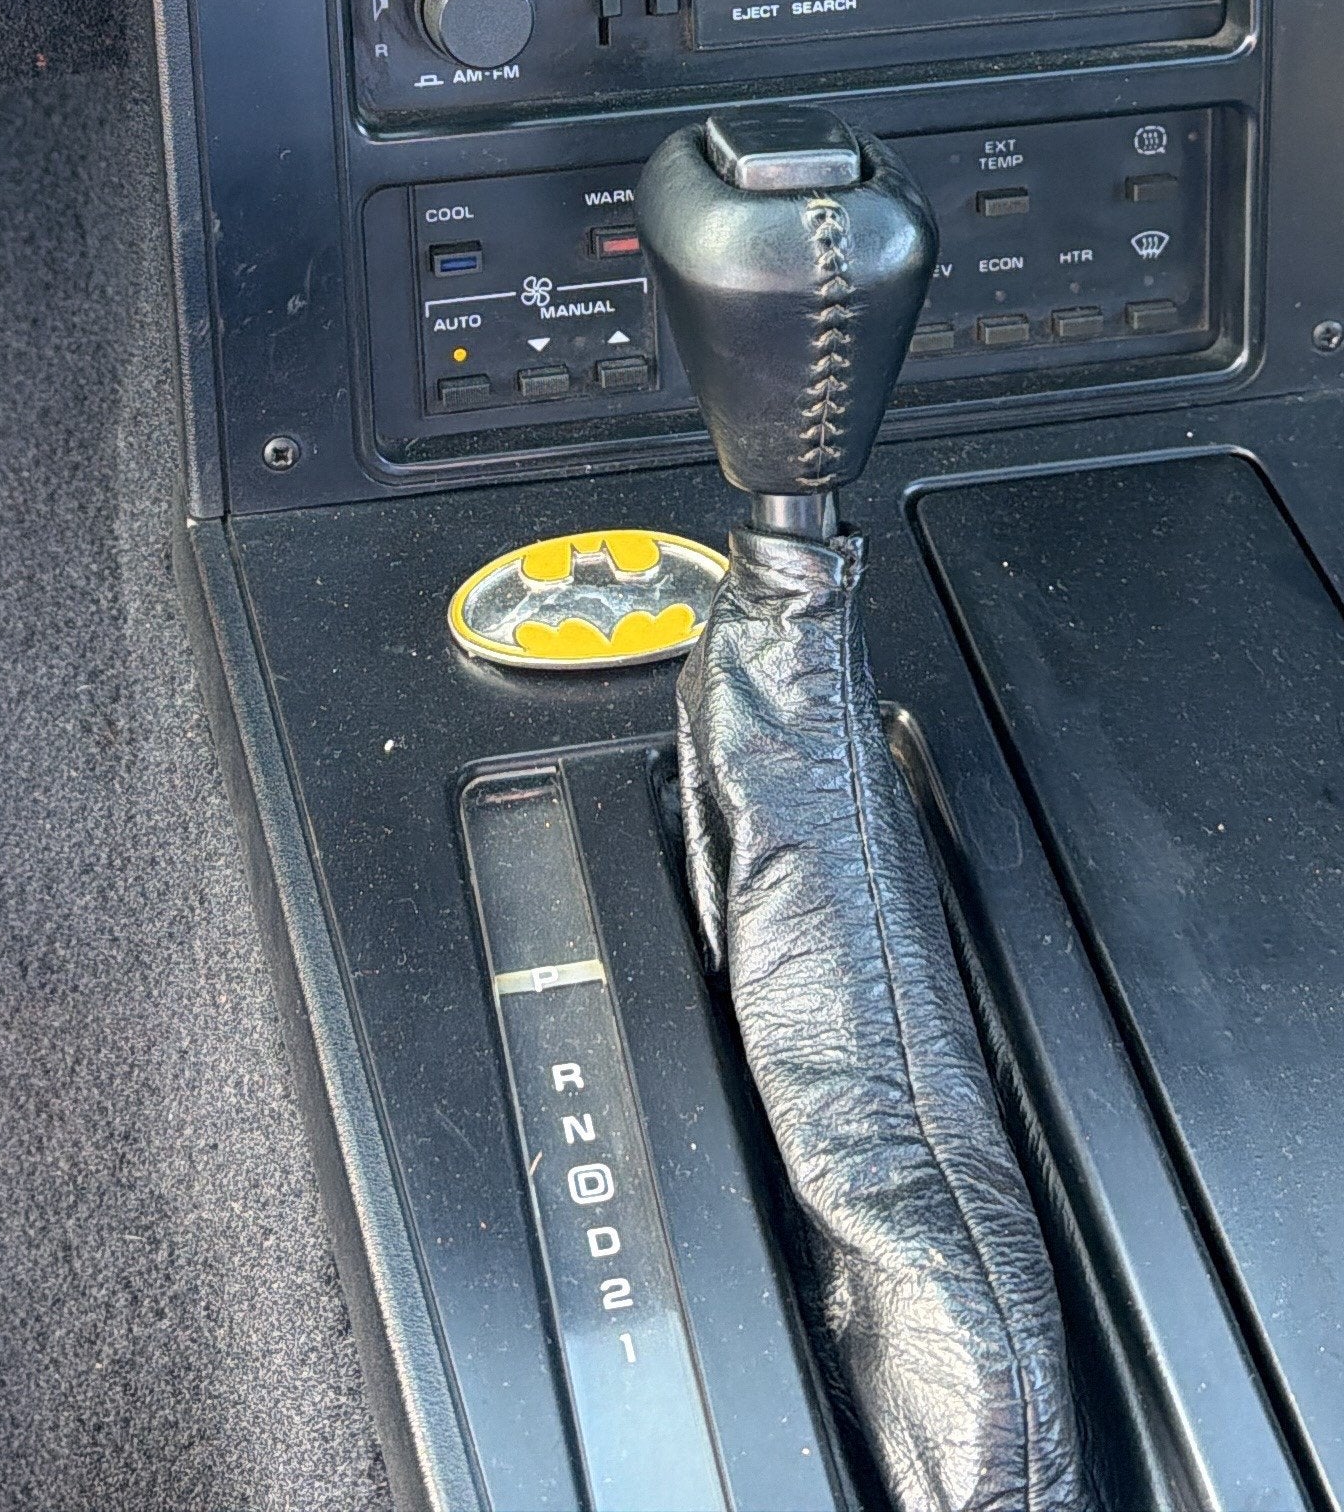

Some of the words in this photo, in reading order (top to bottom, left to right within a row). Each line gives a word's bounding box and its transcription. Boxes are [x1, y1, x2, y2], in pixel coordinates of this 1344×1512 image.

[732, 4, 780, 21] EJECT
[374, 43, 389, 58] R
[984, 138, 1017, 154] EXT
[978, 154, 1024, 170] TEMP
[425, 206, 475, 223] COOL
[978, 256, 1024, 273] ECON
[1059, 249, 1093, 264] HTR
[539, 301, 617, 320] MANUAL
[433, 314, 482, 332] AUTO
[530, 965, 560, 992] P
[551, 1062, 585, 1092] R
[562, 1113, 596, 1145] N
[586, 1226, 621, 1258] D
[599, 1277, 634, 1310] 2
[619, 1332, 637, 1363] 1
